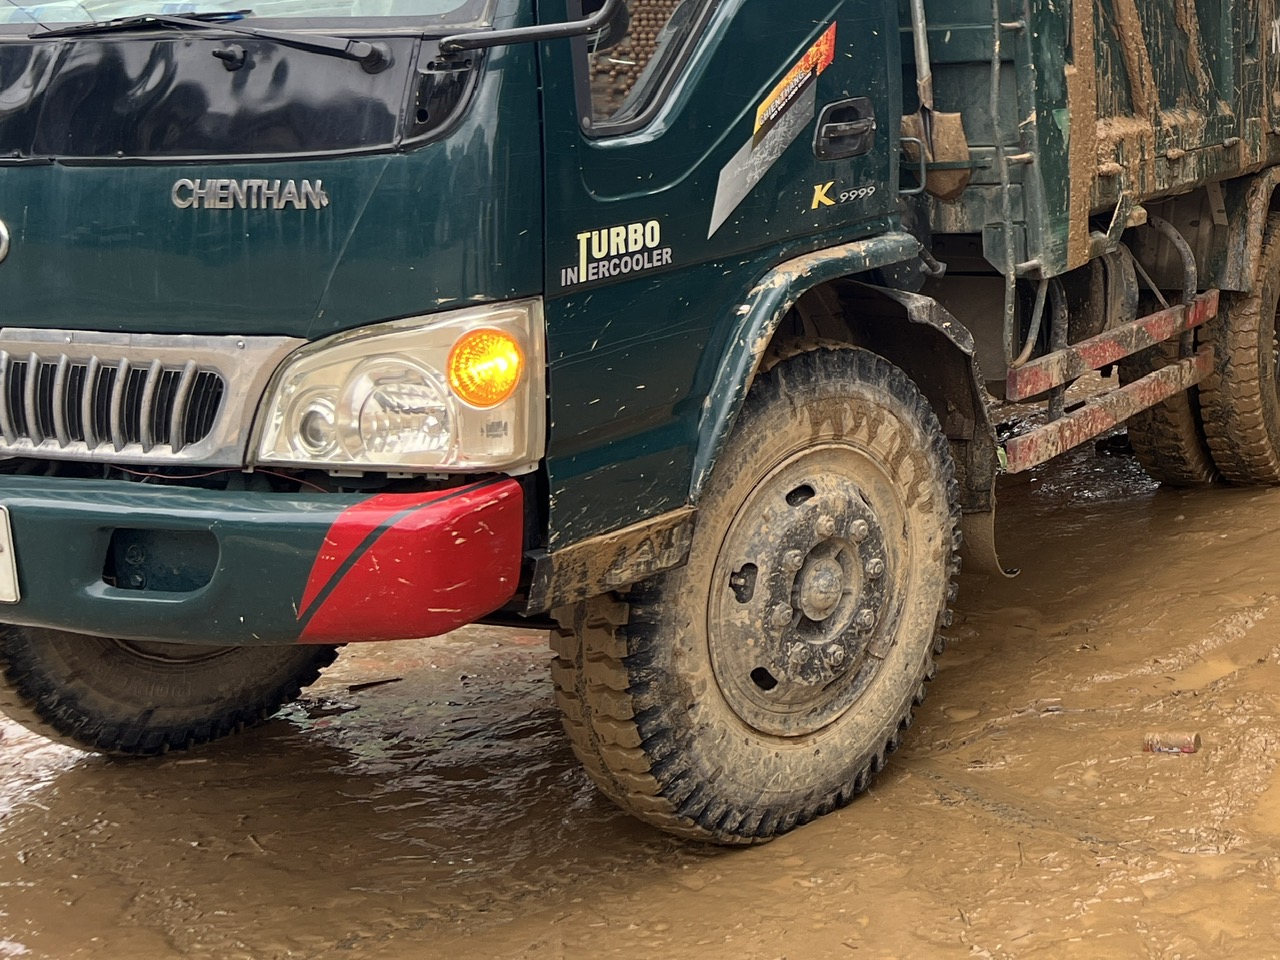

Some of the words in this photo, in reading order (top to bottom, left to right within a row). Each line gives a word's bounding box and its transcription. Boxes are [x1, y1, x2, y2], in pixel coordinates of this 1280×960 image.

[811, 181, 836, 209] K
[839, 186, 876, 203] 9999
[577, 220, 660, 283] TURBO
